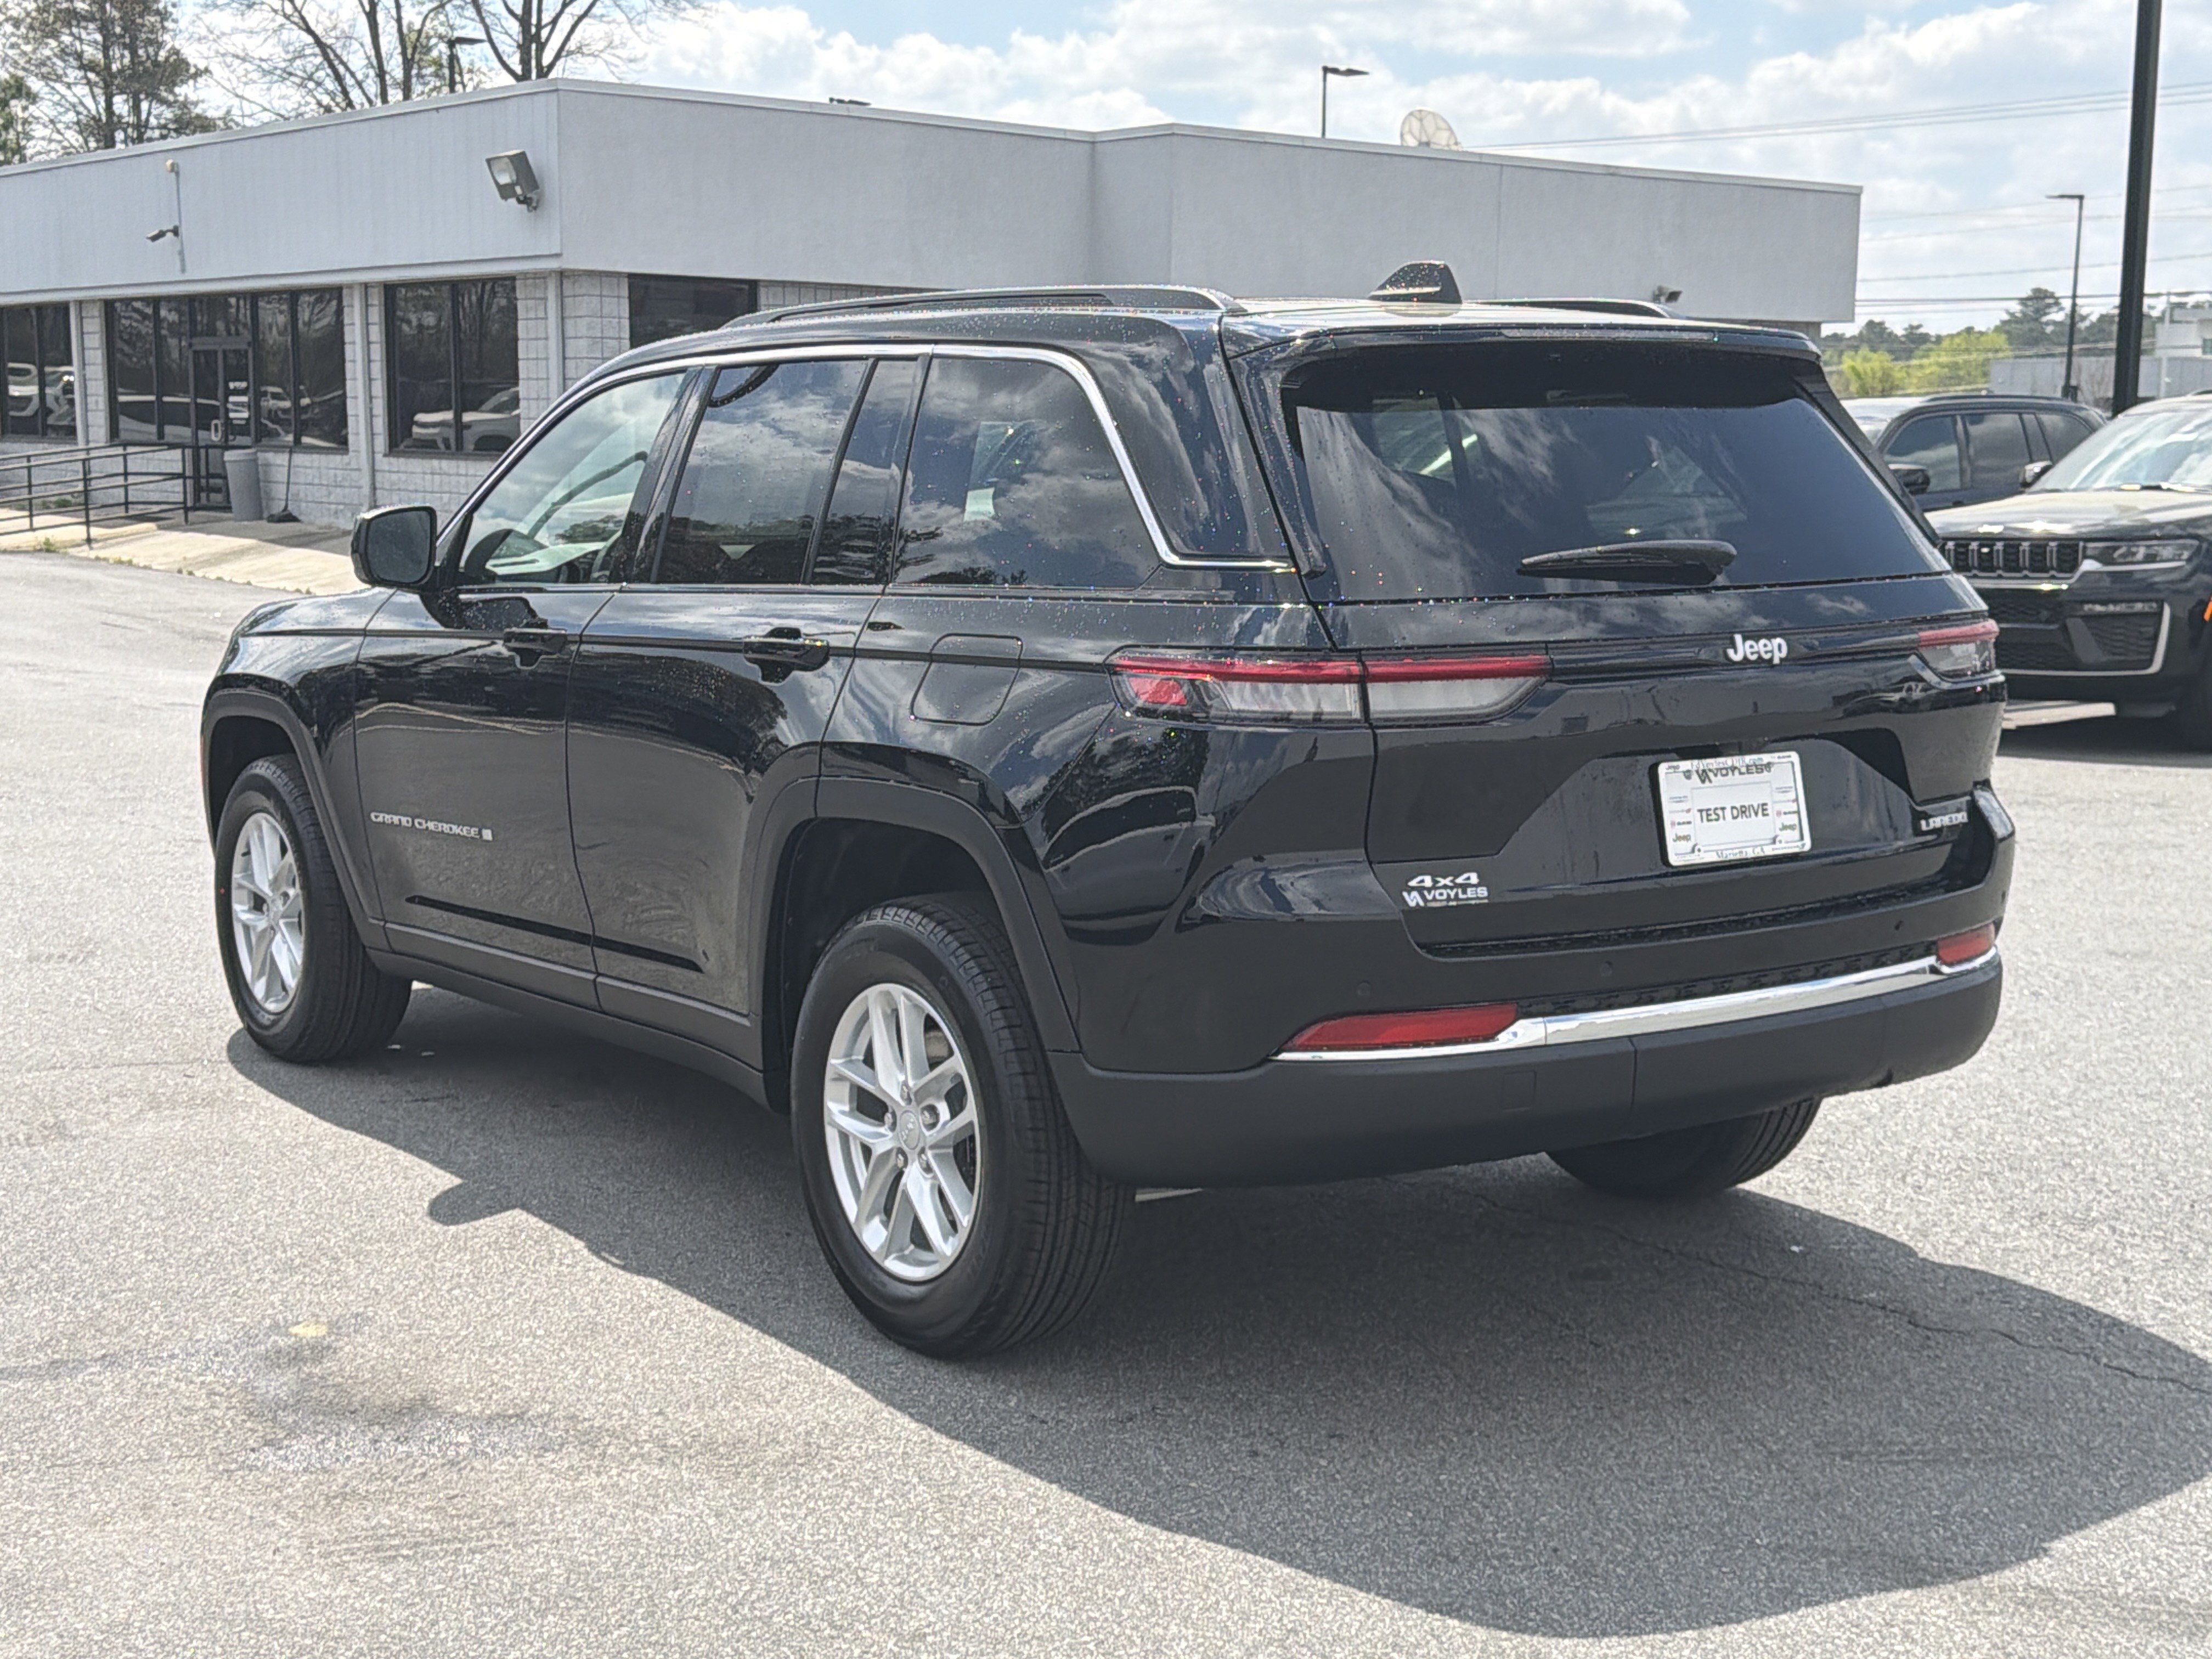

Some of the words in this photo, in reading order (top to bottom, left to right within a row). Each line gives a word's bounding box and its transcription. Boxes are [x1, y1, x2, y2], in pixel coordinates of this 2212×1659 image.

[1726, 633, 1788, 664] Jeep
[1709, 763, 1764, 777] VOYLES
[1697, 806, 1726, 823] TEST
[1730, 802, 1769, 820] DRIVE
[370, 812, 411, 828] GRAND
[414, 819, 479, 839] CHEROKEE
[1672, 832, 1691, 843] Jeep
[1407, 872, 1480, 888] 4x4
[1424, 887, 1488, 900] VOYLES
